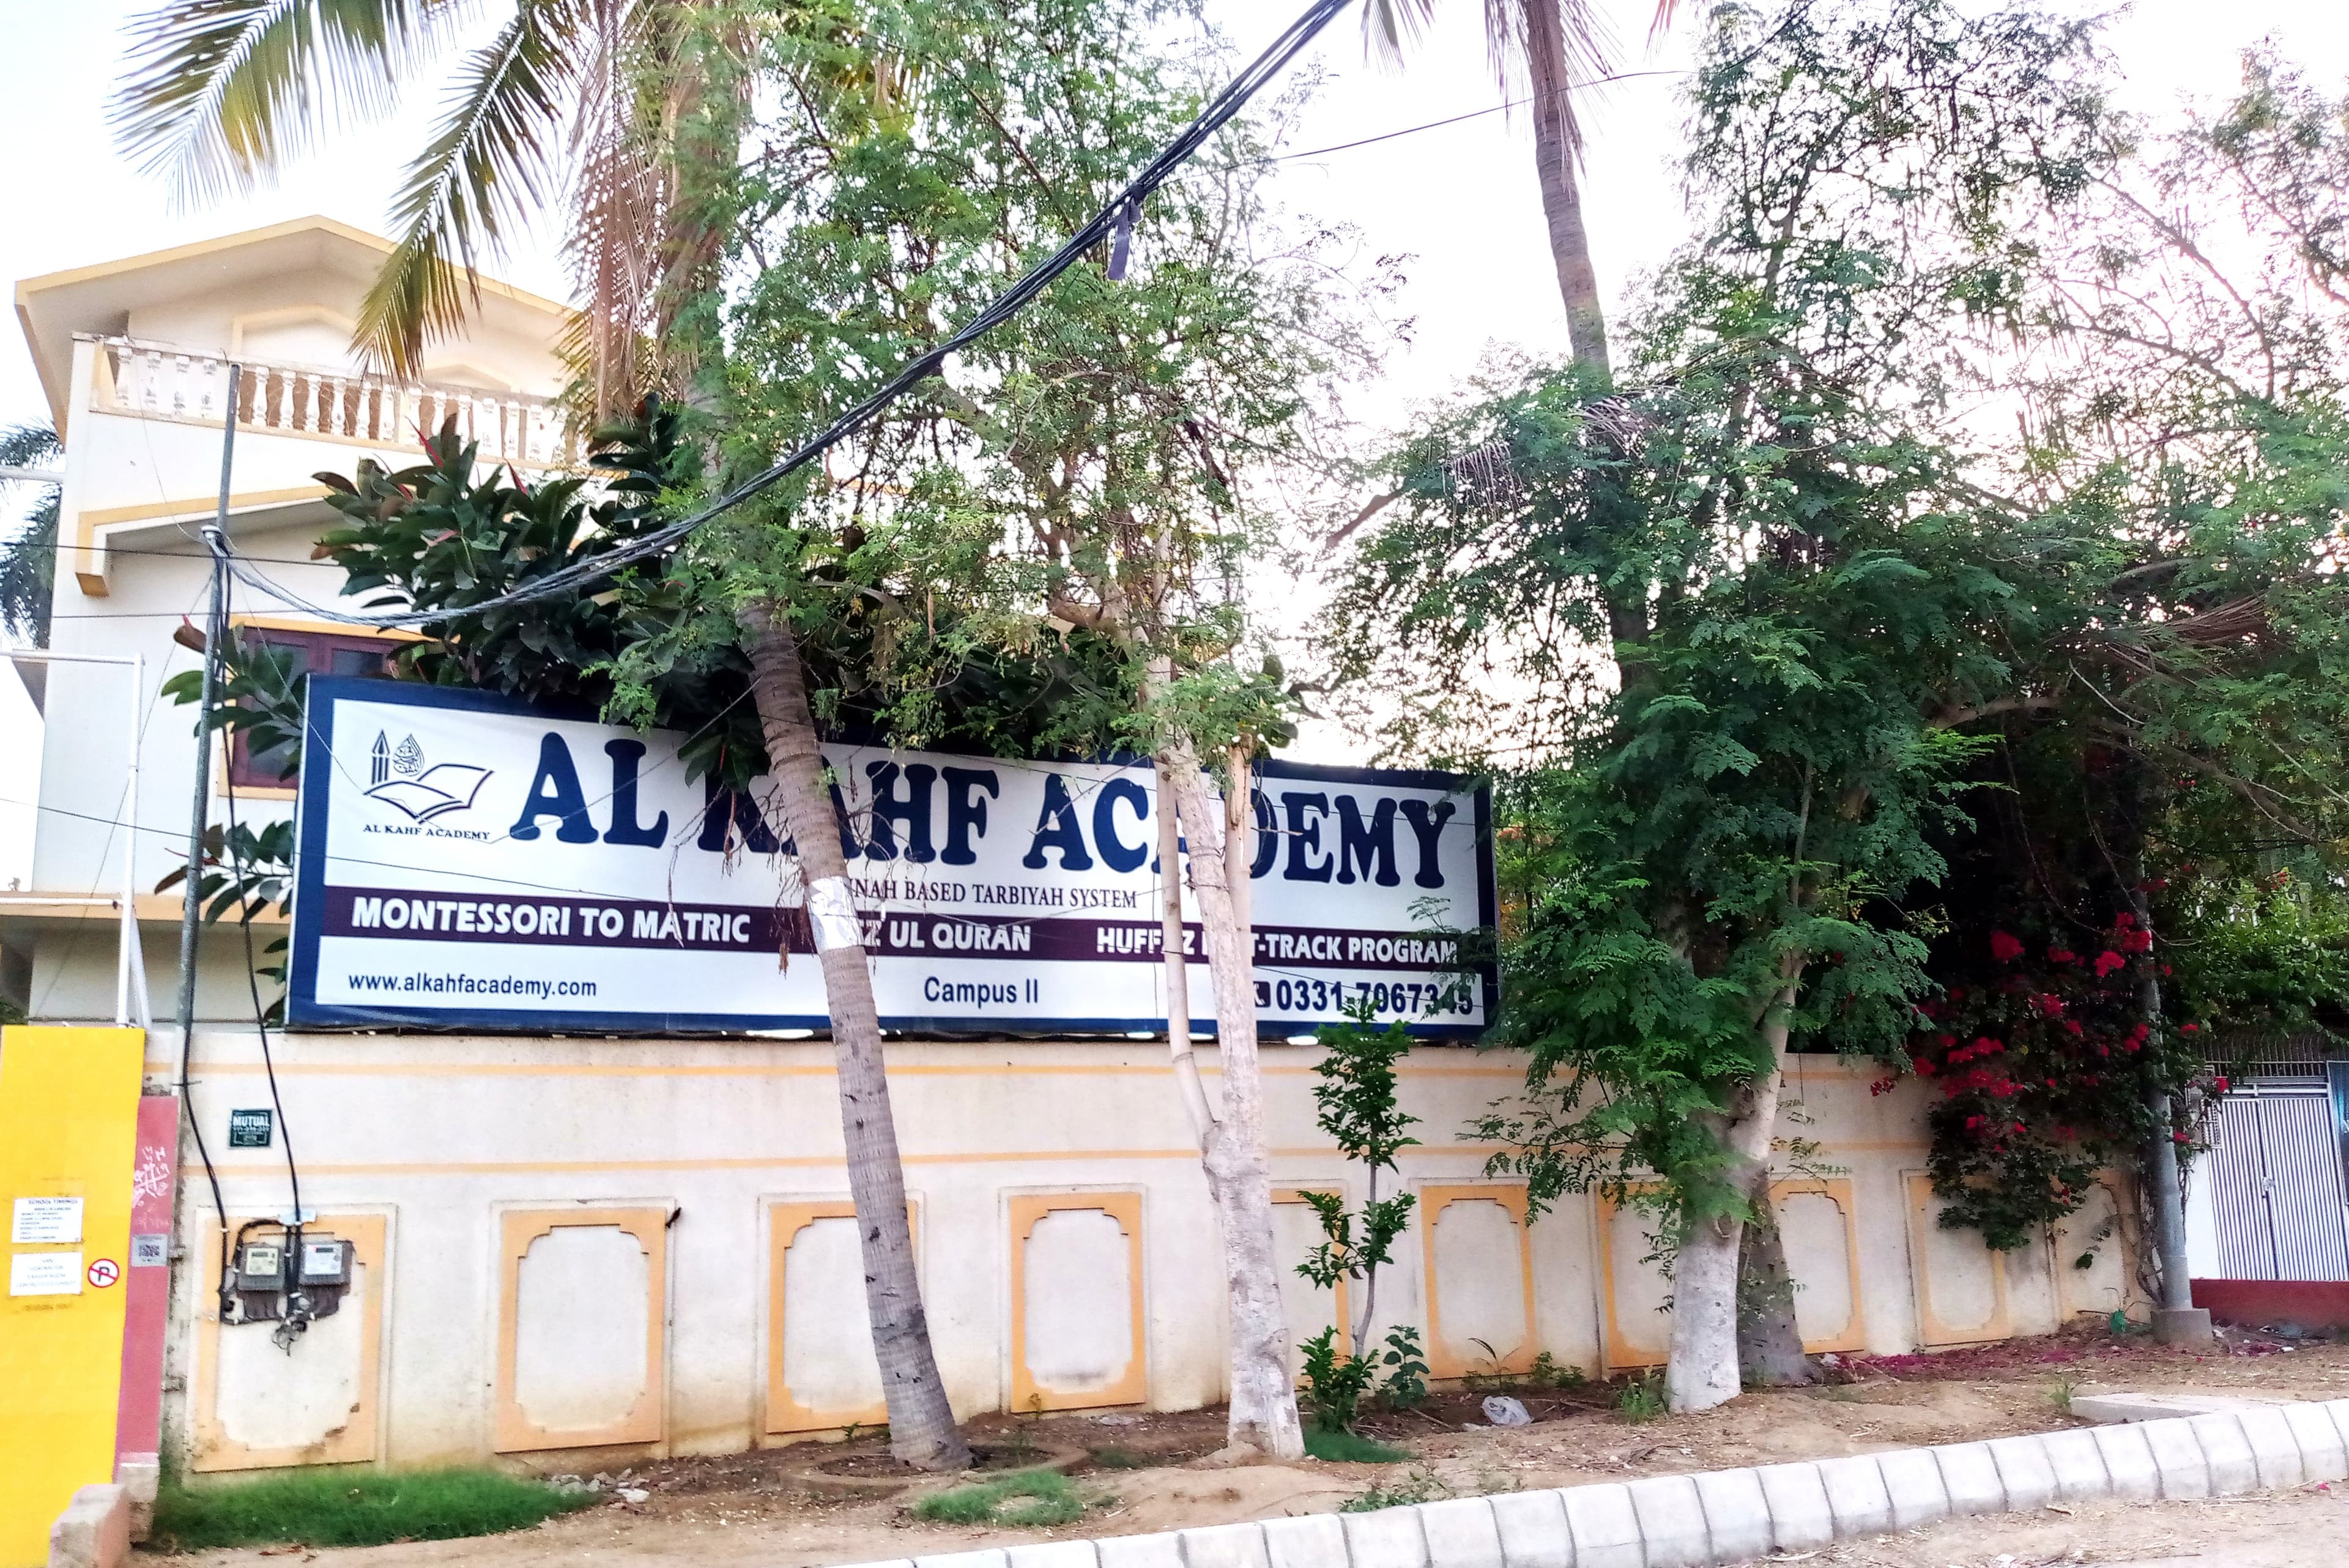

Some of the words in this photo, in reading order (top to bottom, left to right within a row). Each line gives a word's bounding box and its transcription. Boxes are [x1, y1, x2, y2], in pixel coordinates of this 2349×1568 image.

[510, 732, 669, 849] AL
[1023, 772, 1455, 889] ACDEMY
[363, 824, 380, 833] AL
[385, 825, 421, 836] KAHF
[426, 828, 489, 839] ACADEMY
[904, 882, 965, 903] BASED
[973, 884, 1063, 907] TARBIYAH
[1070, 888, 1137, 908] SYSTEM
[352, 897, 570, 936] MONTESSORI
[579, 908, 624, 938] TO
[633, 910, 751, 944] MATRIC
[889, 920, 925, 949] UL
[932, 923, 1031, 951] QURAN
[1097, 927, 1195, 955] HUFFZ
[1348, 936, 1458, 964] PROGRAM
[348, 973, 596, 1000] www.alkahfacademy.com
[924, 976, 1016, 1008] Campus
[1025, 979, 1039, 1003] II
[232, 1115, 270, 1126] MUTUAL
